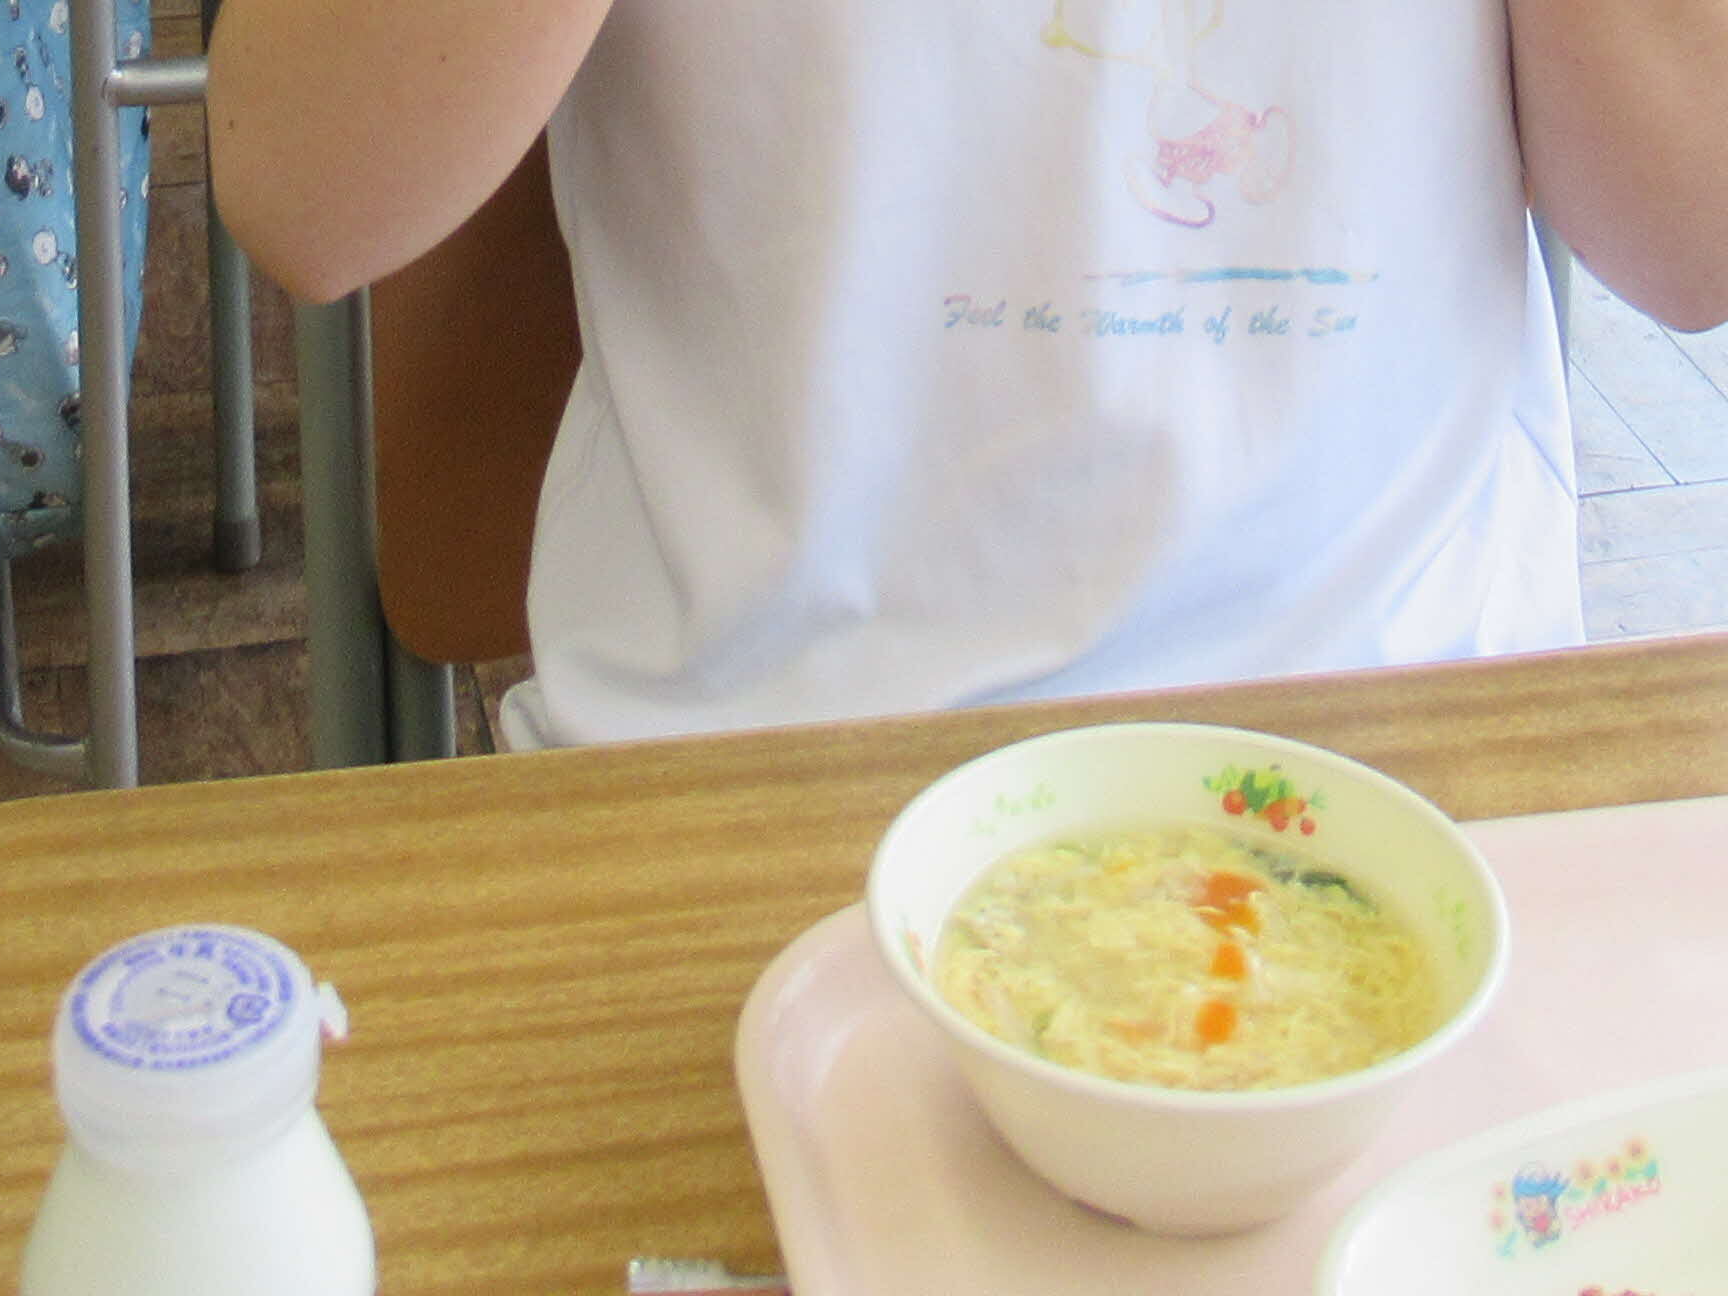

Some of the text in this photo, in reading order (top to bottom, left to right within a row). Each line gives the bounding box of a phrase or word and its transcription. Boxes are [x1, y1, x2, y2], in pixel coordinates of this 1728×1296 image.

[943, 294, 1007, 329] Feel
[1022, 302, 1062, 335] the
[1080, 305, 1186, 337] Warmth
[1203, 305, 1233, 346] of
[1247, 304, 1291, 336] the
